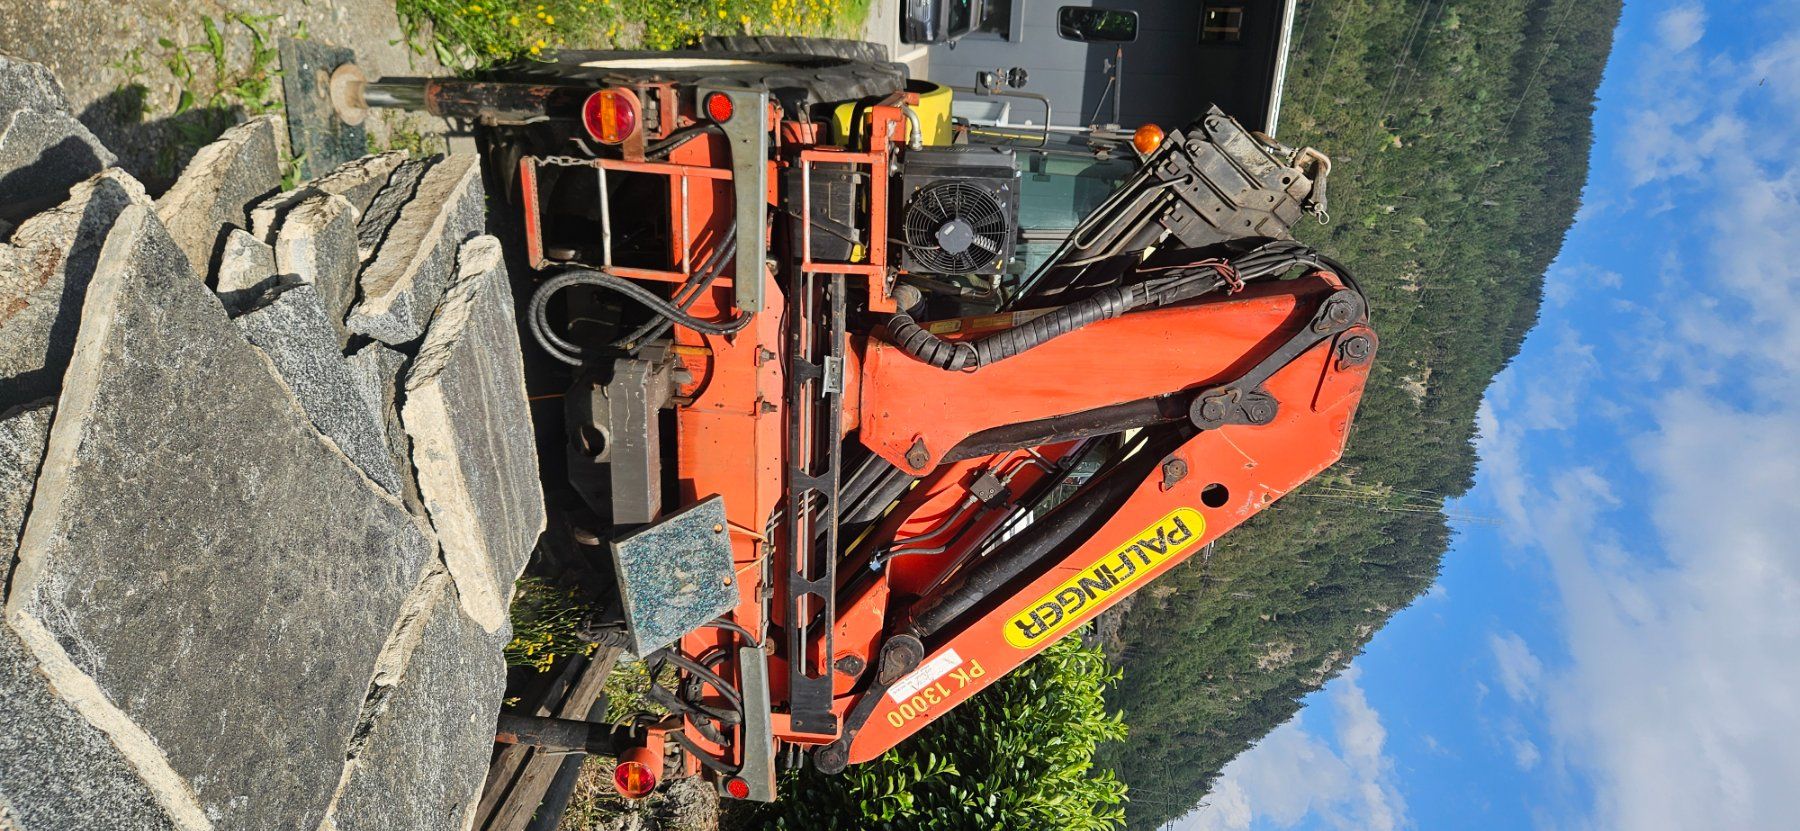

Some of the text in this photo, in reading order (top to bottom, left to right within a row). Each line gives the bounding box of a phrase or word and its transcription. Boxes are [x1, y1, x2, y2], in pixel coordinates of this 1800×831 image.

[1014, 516, 1192, 639] PALFINGER
[951, 658, 986, 688] PK
[887, 681, 951, 729] 13000
